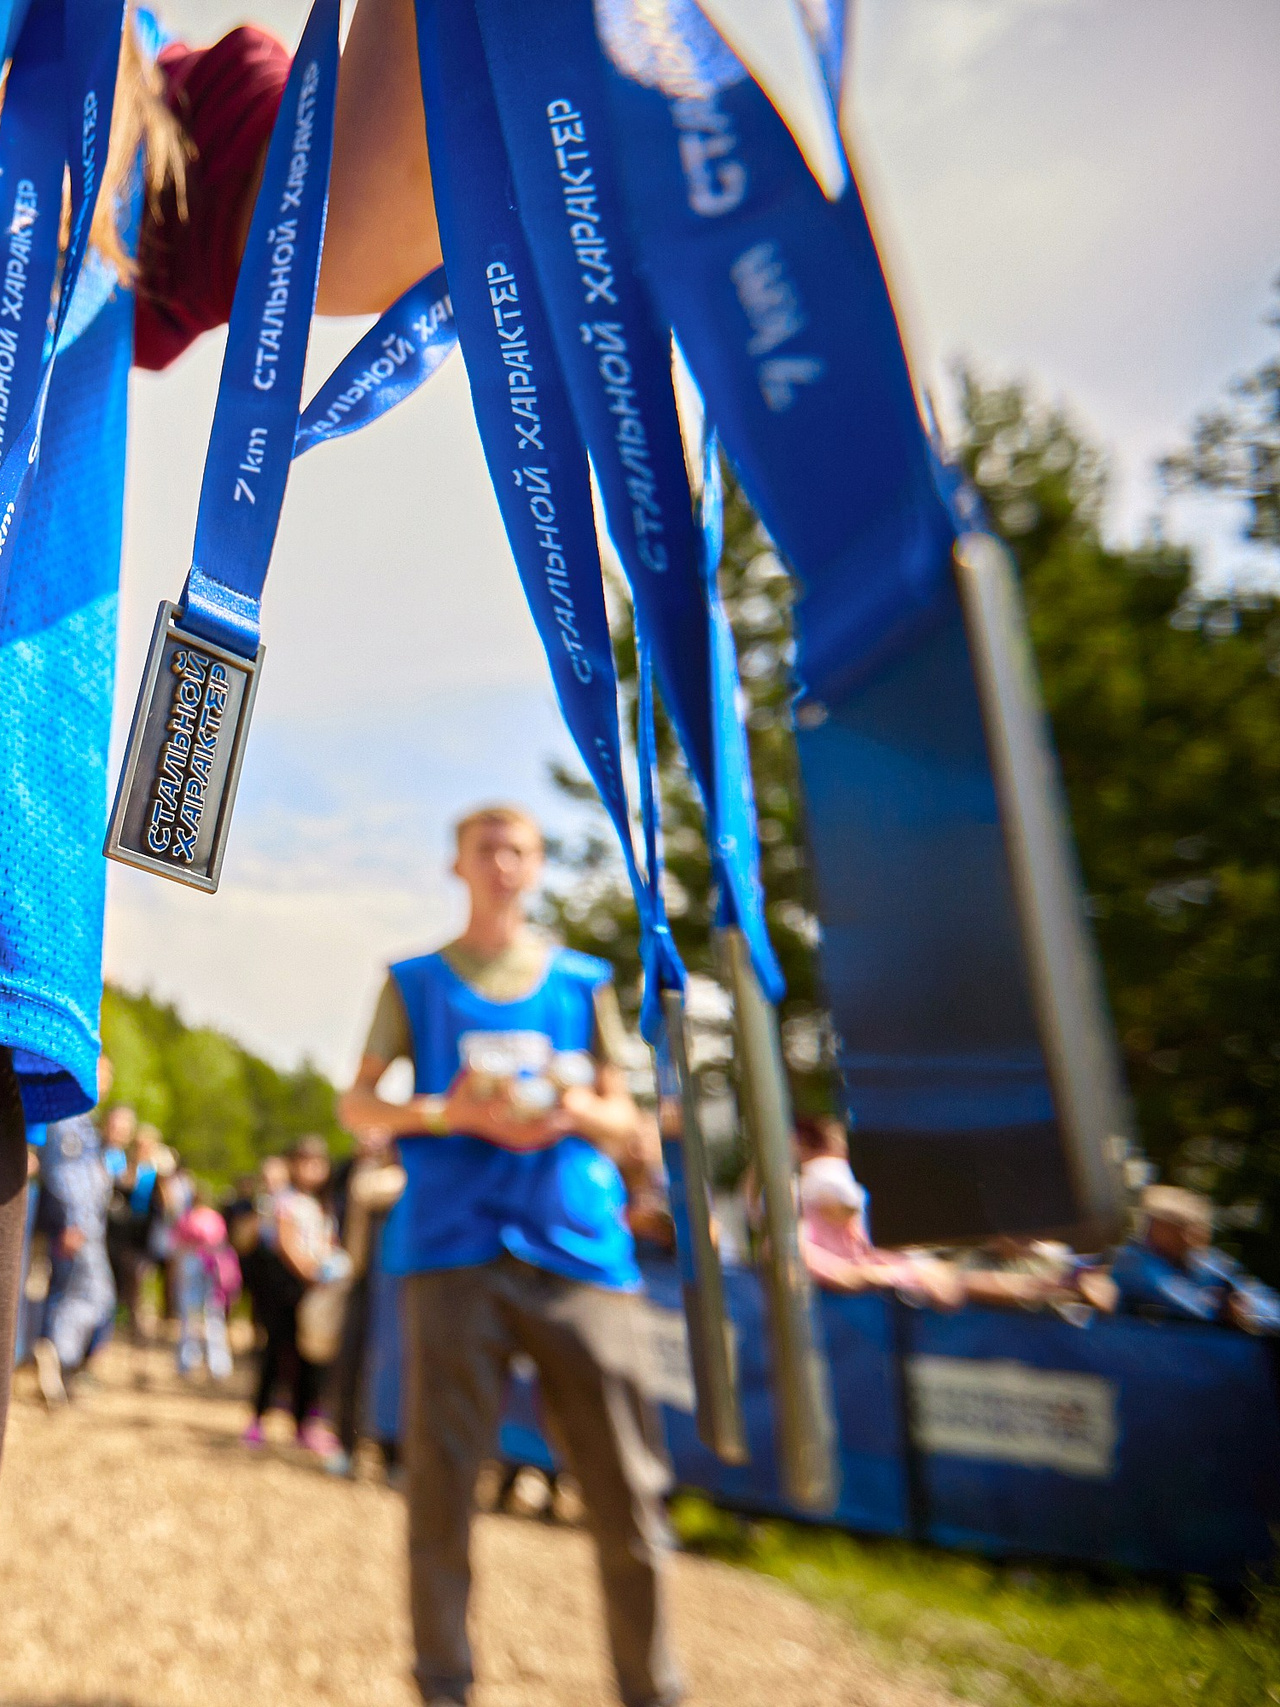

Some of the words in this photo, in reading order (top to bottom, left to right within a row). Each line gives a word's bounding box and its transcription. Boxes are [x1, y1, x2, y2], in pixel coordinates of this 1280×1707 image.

[280, 60, 319, 213] ХАРАКТЕР
[546, 98, 618, 306] ХАРАКТЕР
[253, 219, 297, 391] СТАЛЬНОЙ
[486, 261, 545, 450] ХАРАКТЕР
[234, 478, 256, 504] 7
[239, 427, 268, 473] km
[579, 321, 669, 573] СТАЛЬНОЙ
[514, 466, 593, 685] СТАЛЬНОЙ
[146, 651, 210, 854] СТАЛЬНОЙ
[172, 662, 229, 863] ХАРАКТЕР
